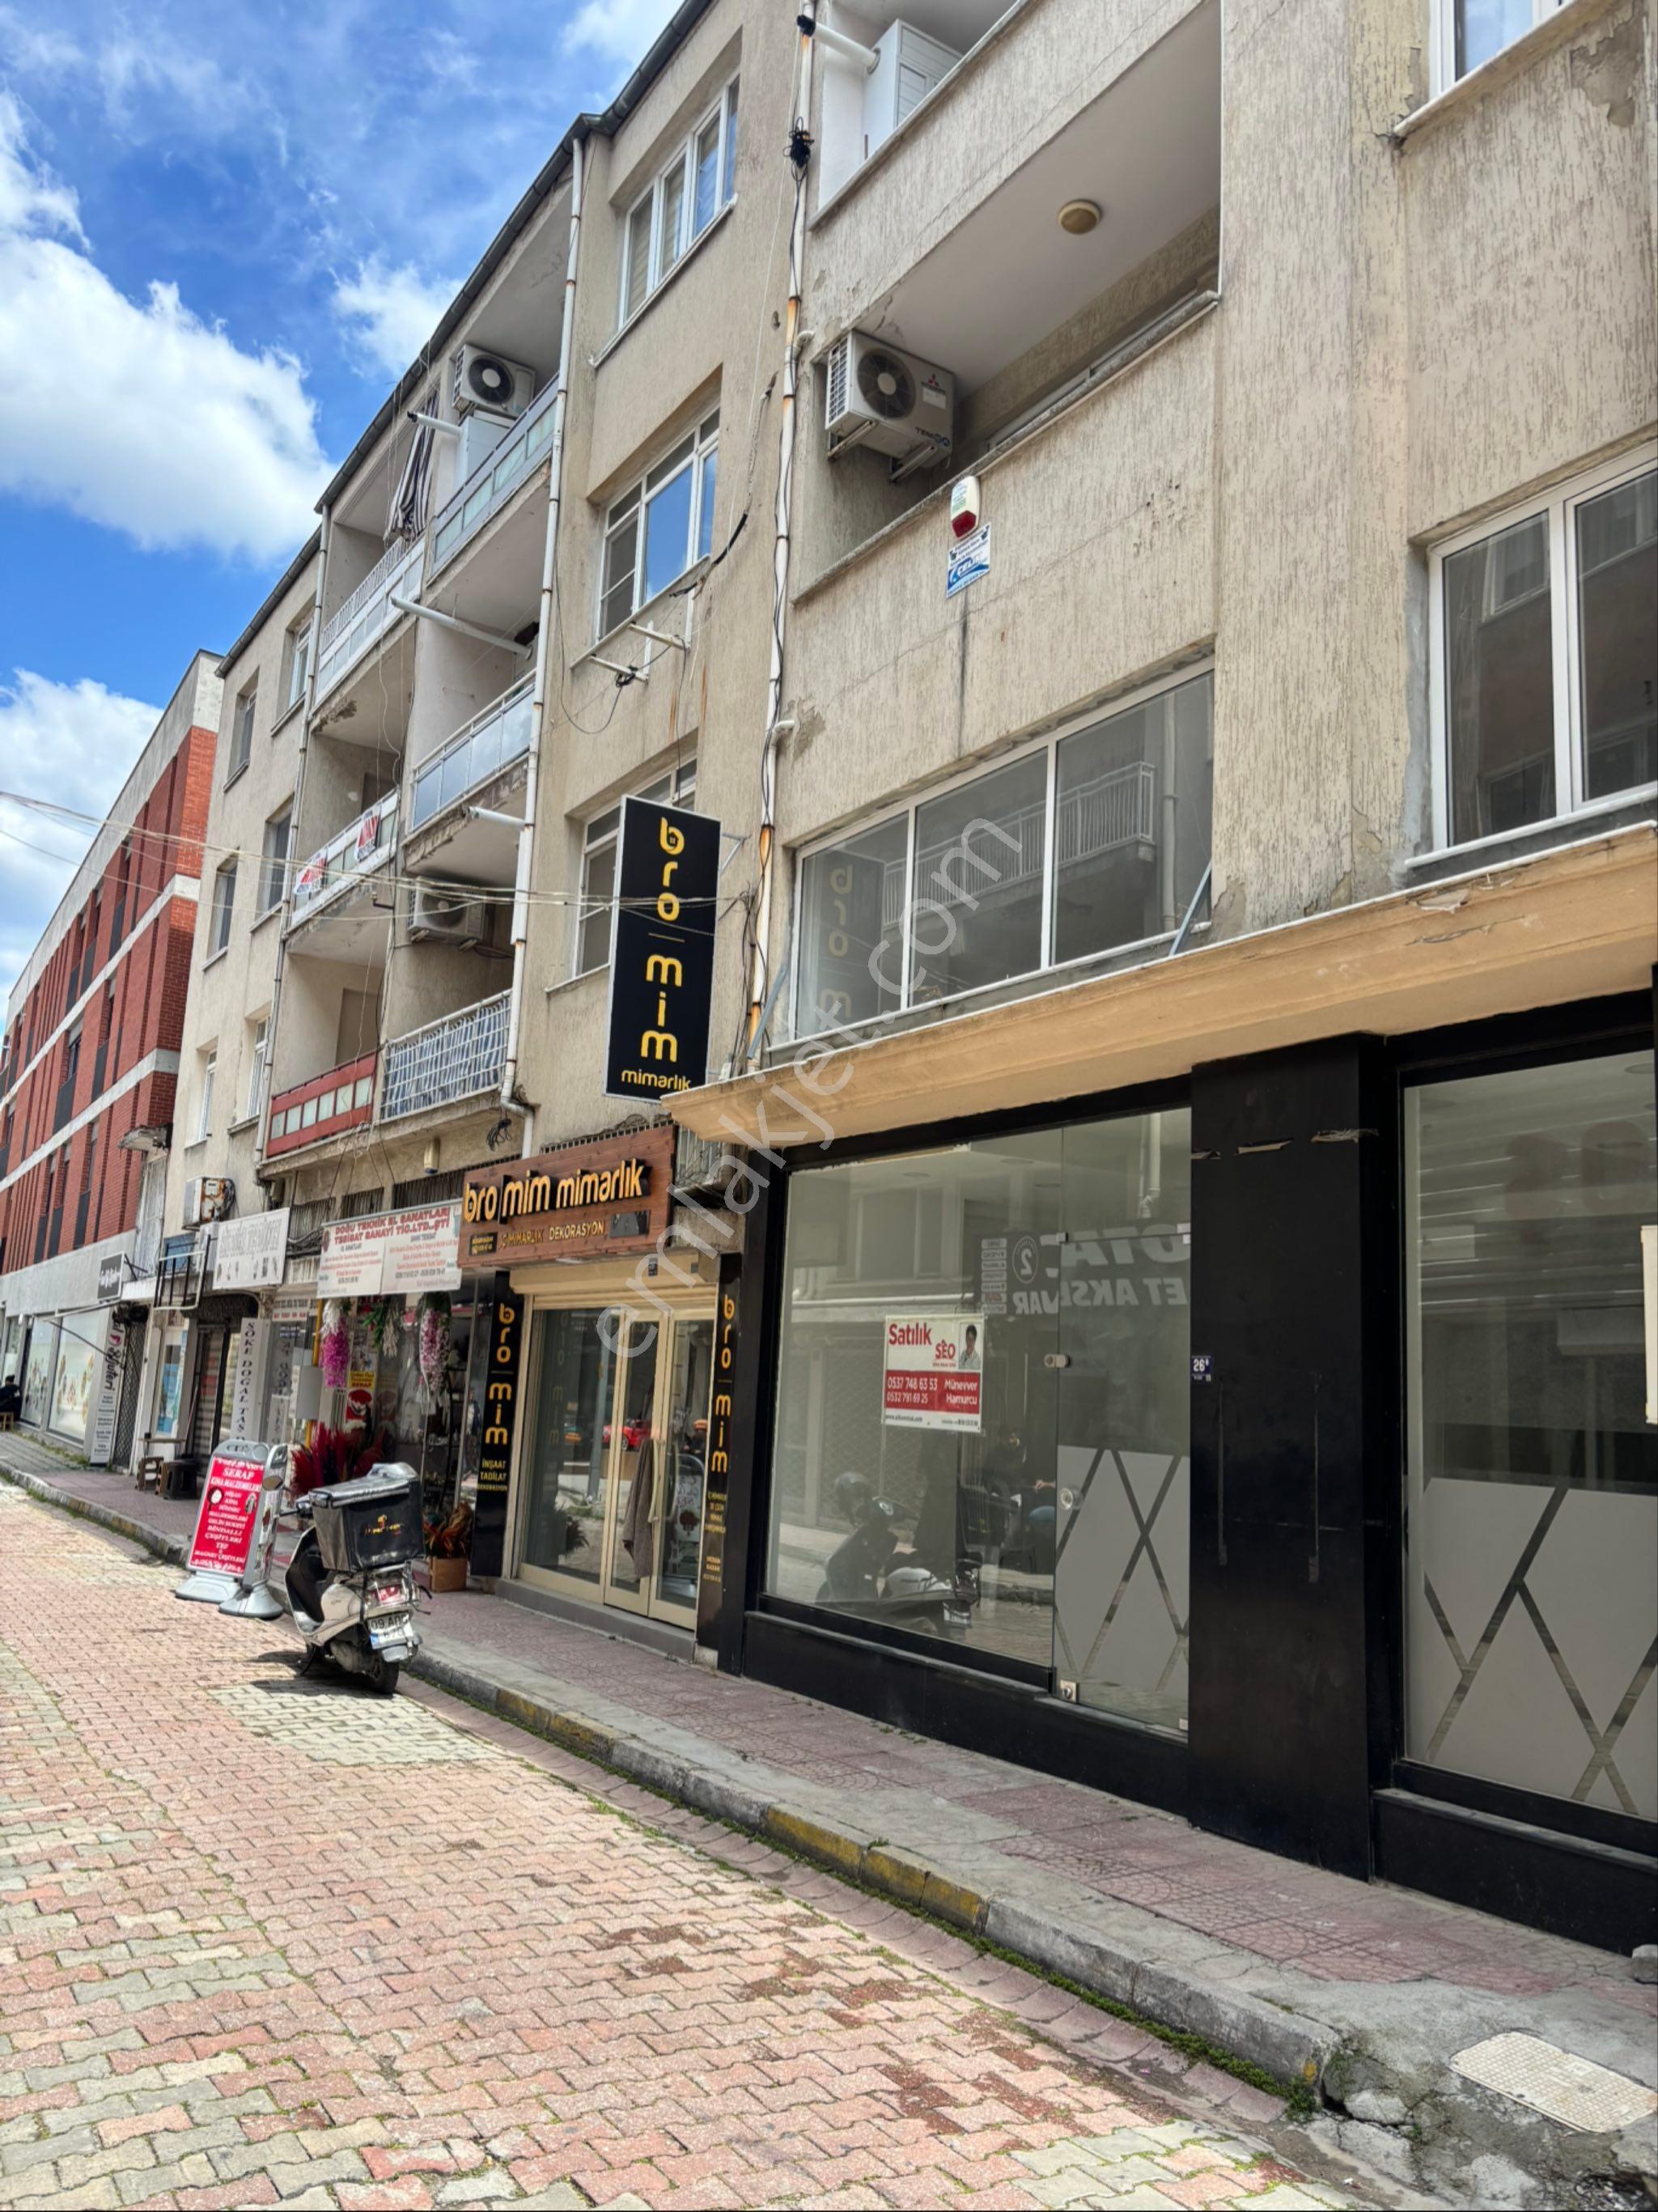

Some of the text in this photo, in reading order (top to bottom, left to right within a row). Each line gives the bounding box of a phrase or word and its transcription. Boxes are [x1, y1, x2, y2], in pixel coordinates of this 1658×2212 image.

[621, 1068, 691, 1092] mimarlık
[464, 1158, 646, 1222] bro mim mimarlık
[549, 1221, 604, 1241] DEKORASYON
[888, 1321, 932, 1346] Satılık
[935, 1339, 956, 1360] SEO
[888, 1377, 938, 1391] 0537 748 63 53
[944, 1378, 977, 1391] Münevver
[887, 1391, 901, 1403] 0532
[946, 1393, 977, 1405] Hamurcu
[481, 1457, 507, 1470] İNŞAAT
[223, 1467, 255, 1480] SERAP
[480, 1470, 507, 1482] TADİLAT
